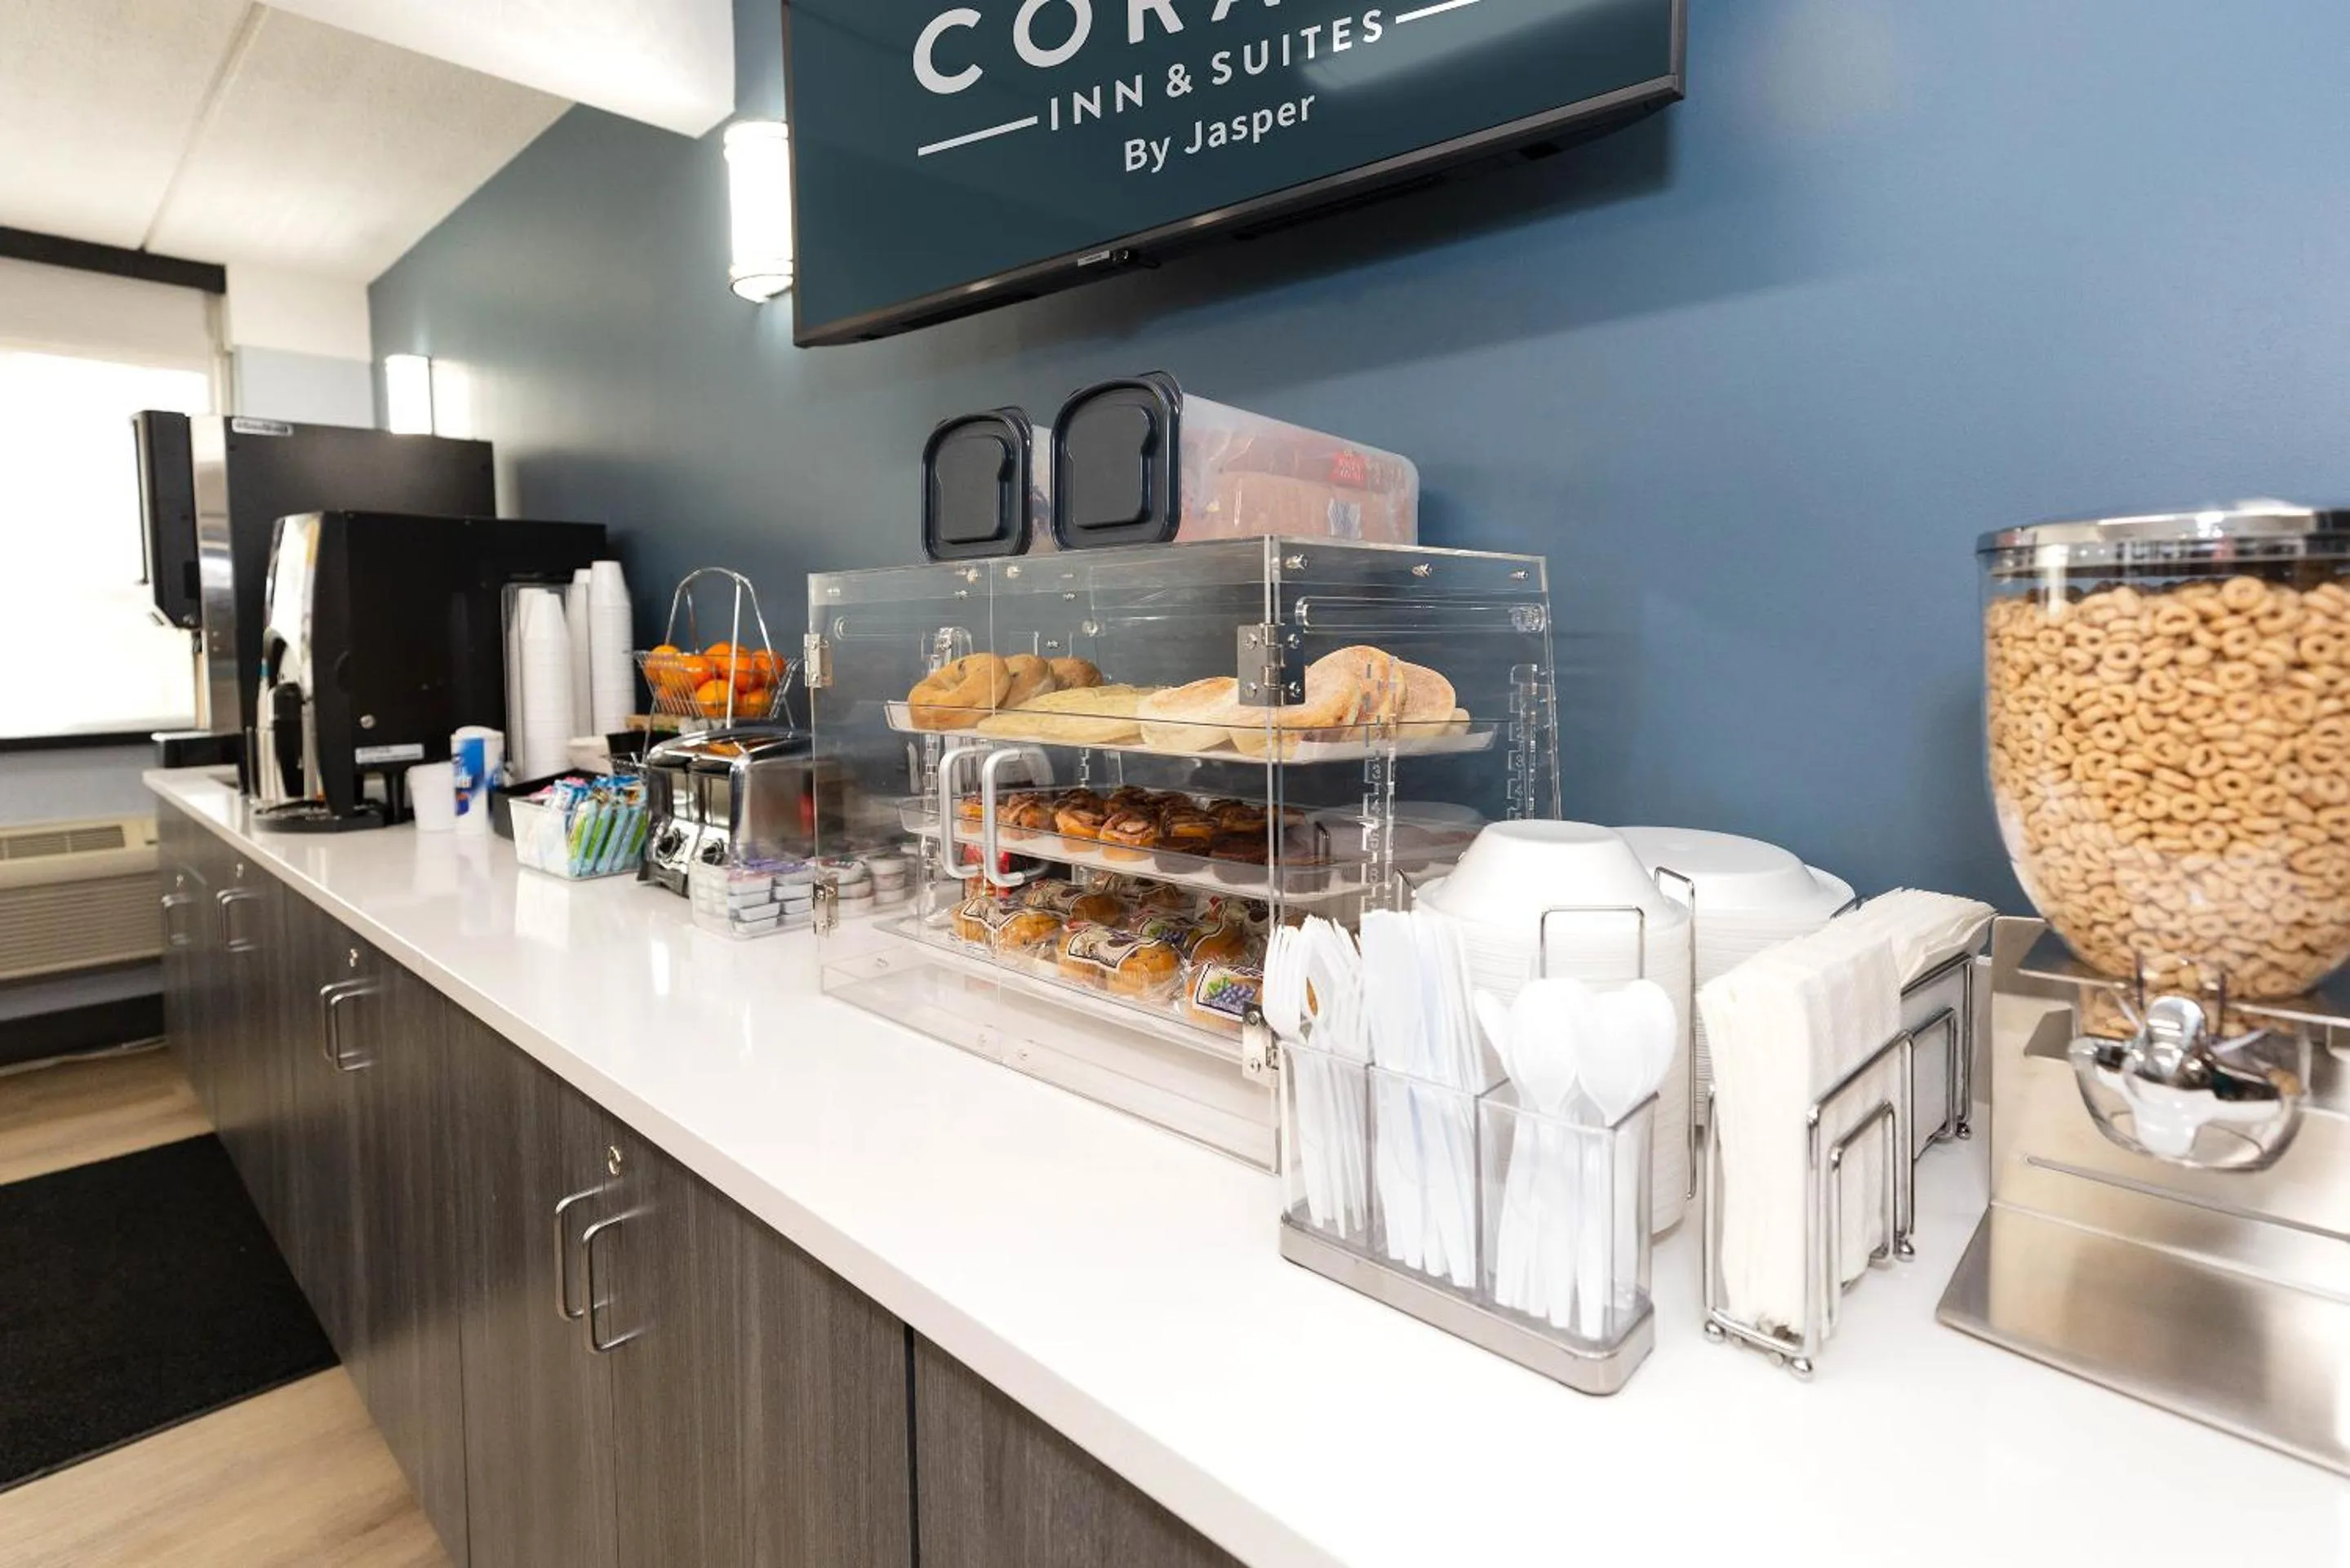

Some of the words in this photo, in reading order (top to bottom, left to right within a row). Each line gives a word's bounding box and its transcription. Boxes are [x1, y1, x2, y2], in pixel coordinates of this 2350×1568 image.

[912, 0, 1282, 95] COR
[1050, 73, 1144, 131] INN
[1166, 63, 1193, 98] &
[1211, 8, 1384, 86] SUITES
[1124, 137, 1171, 173] By
[1184, 94, 1316, 155] Jasper
